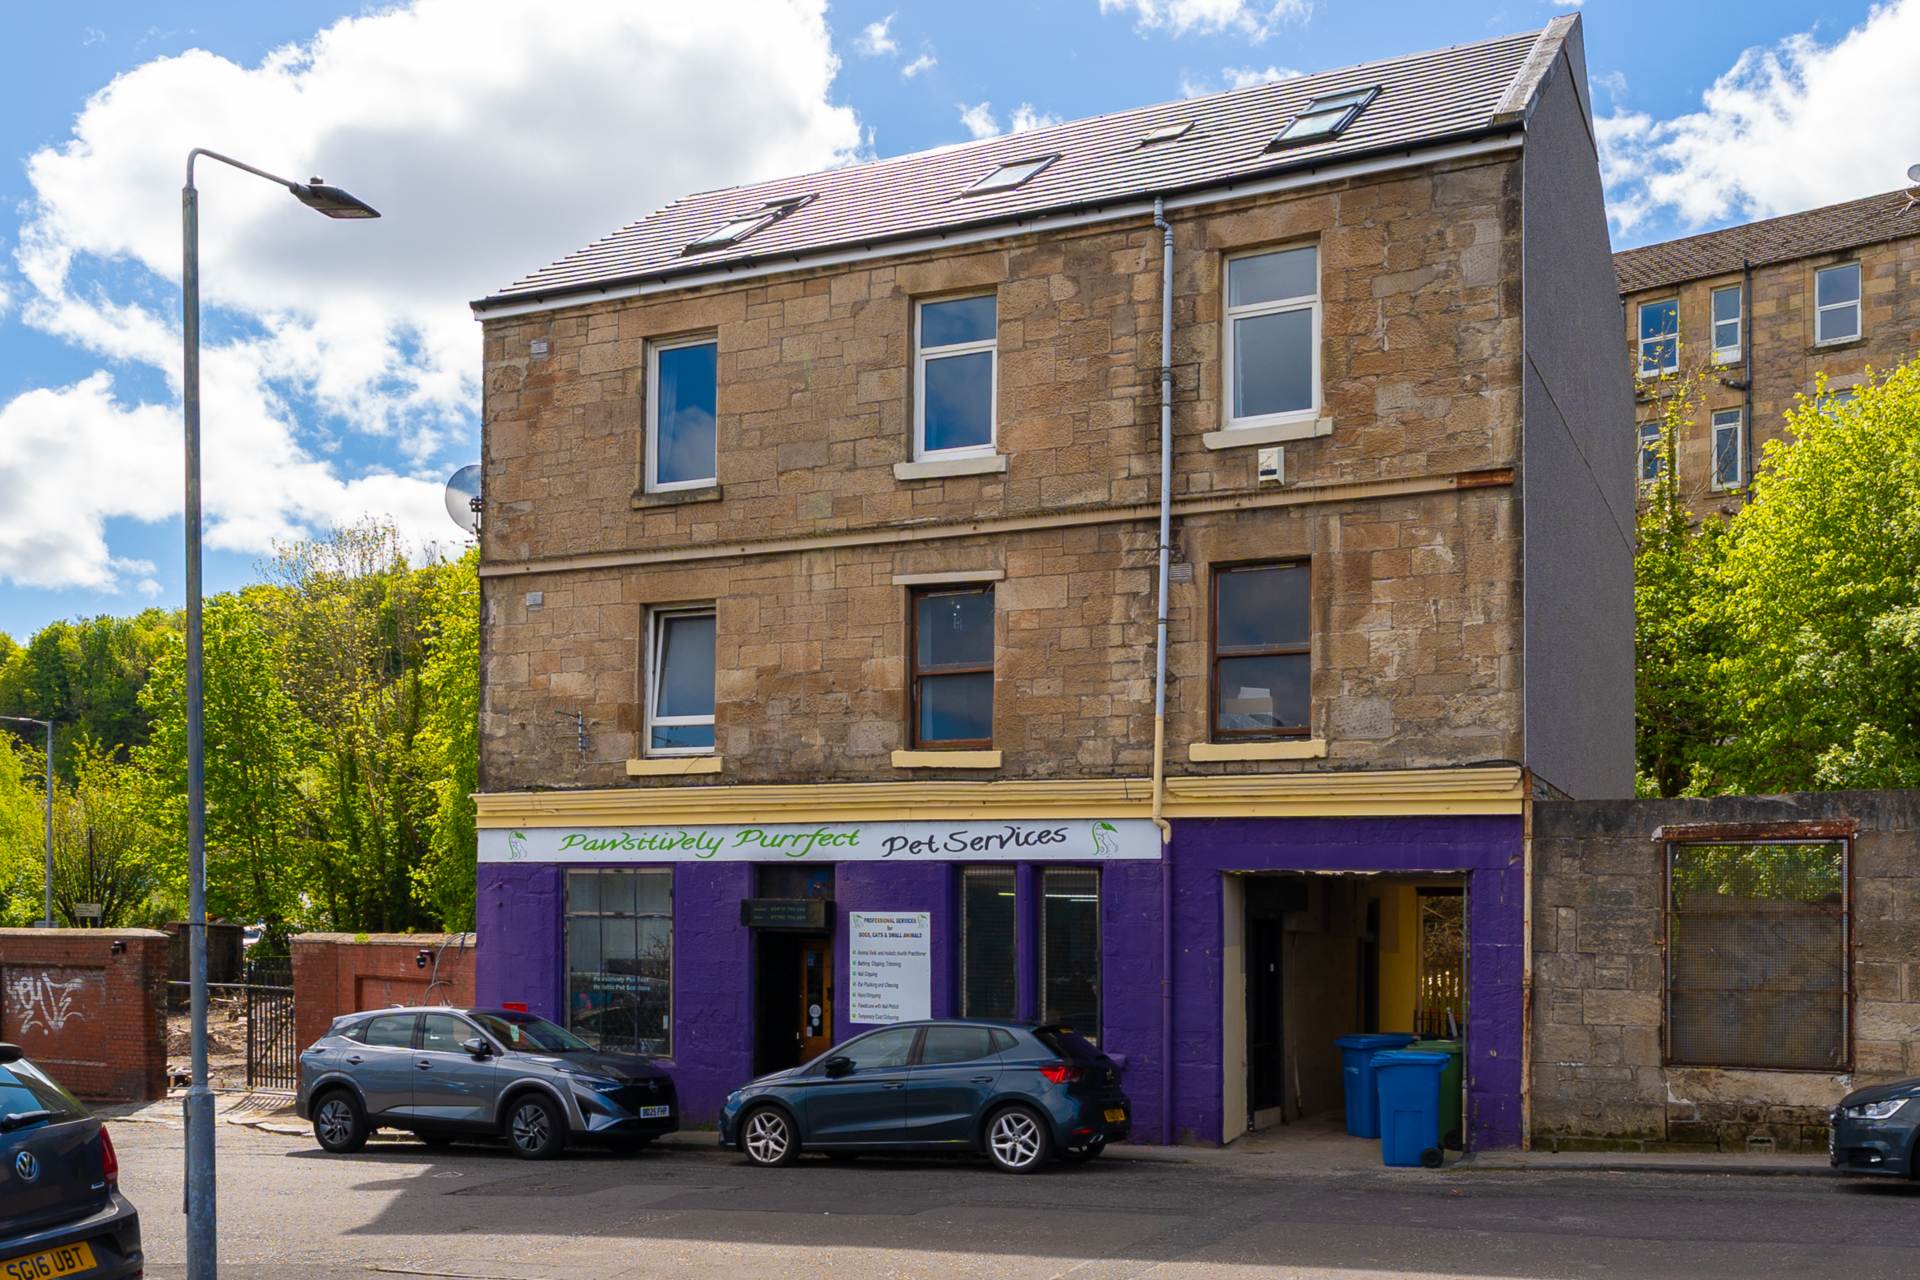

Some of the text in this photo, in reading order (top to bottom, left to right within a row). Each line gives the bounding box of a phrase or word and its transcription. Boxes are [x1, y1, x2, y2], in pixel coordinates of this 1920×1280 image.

[558, 826, 1068, 858] Pawsitively Purrfect Pet Services
[6, 1247, 84, 1280] SG16 UBT
